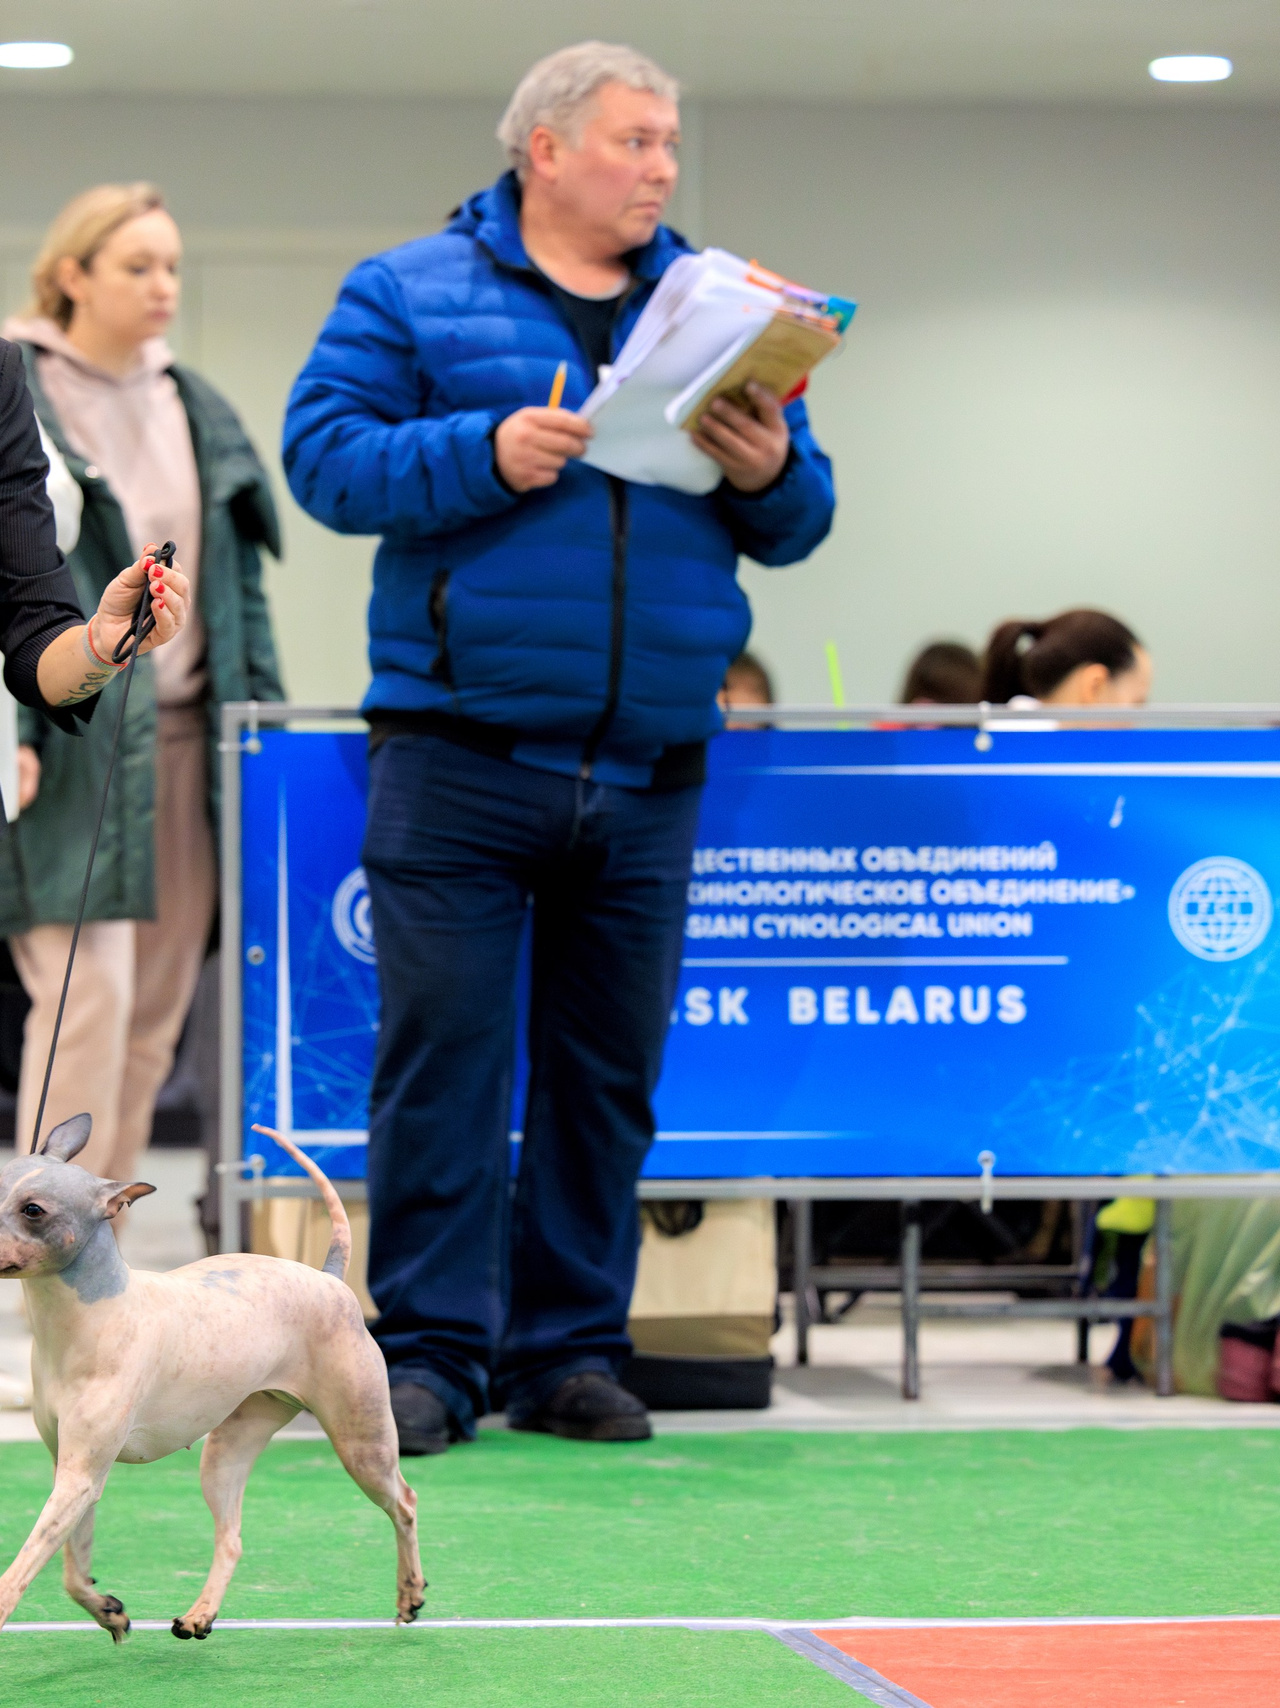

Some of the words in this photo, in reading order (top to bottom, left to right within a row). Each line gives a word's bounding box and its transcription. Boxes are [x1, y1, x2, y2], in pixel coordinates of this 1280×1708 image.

[861, 841, 1057, 875] ОБЪЕДИНЕНИЙ
[753, 912, 944, 938] CYNOLOGICAL
[947, 911, 1033, 938] UNION
[671, 986, 749, 1026] SK
[788, 985, 1027, 1025] BELARUS
